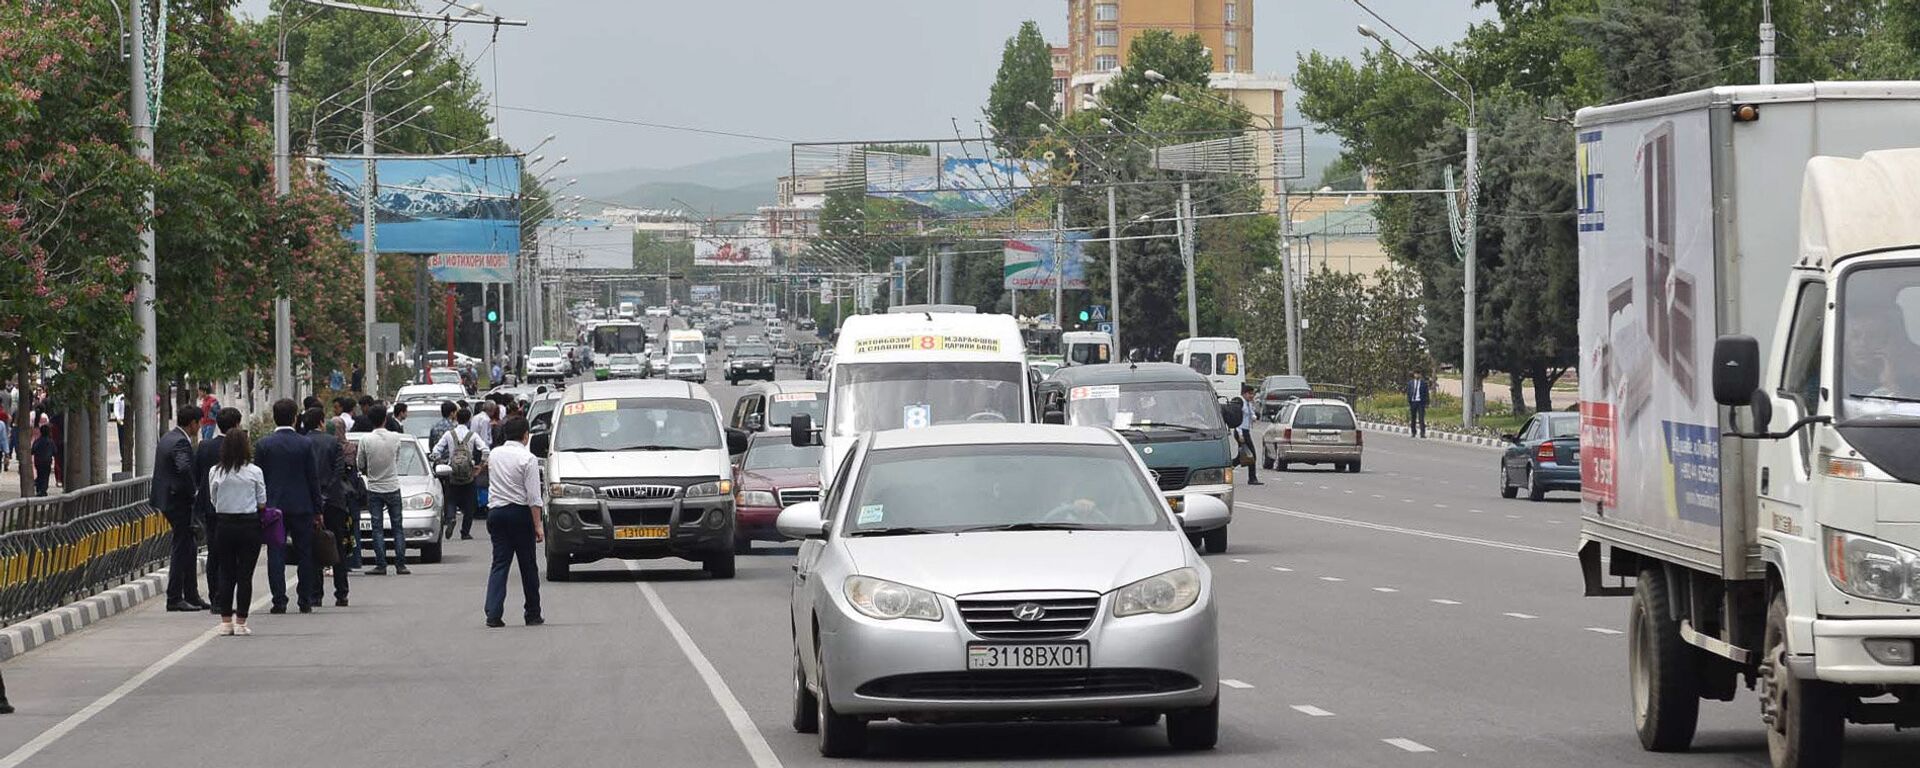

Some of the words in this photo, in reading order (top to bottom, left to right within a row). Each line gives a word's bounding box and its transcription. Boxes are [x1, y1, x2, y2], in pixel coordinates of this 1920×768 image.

[920, 336, 935, 350] 8
[566, 402, 585, 416] 19
[907, 407, 927, 430] 8
[988, 646, 1083, 667] 3118BX01
